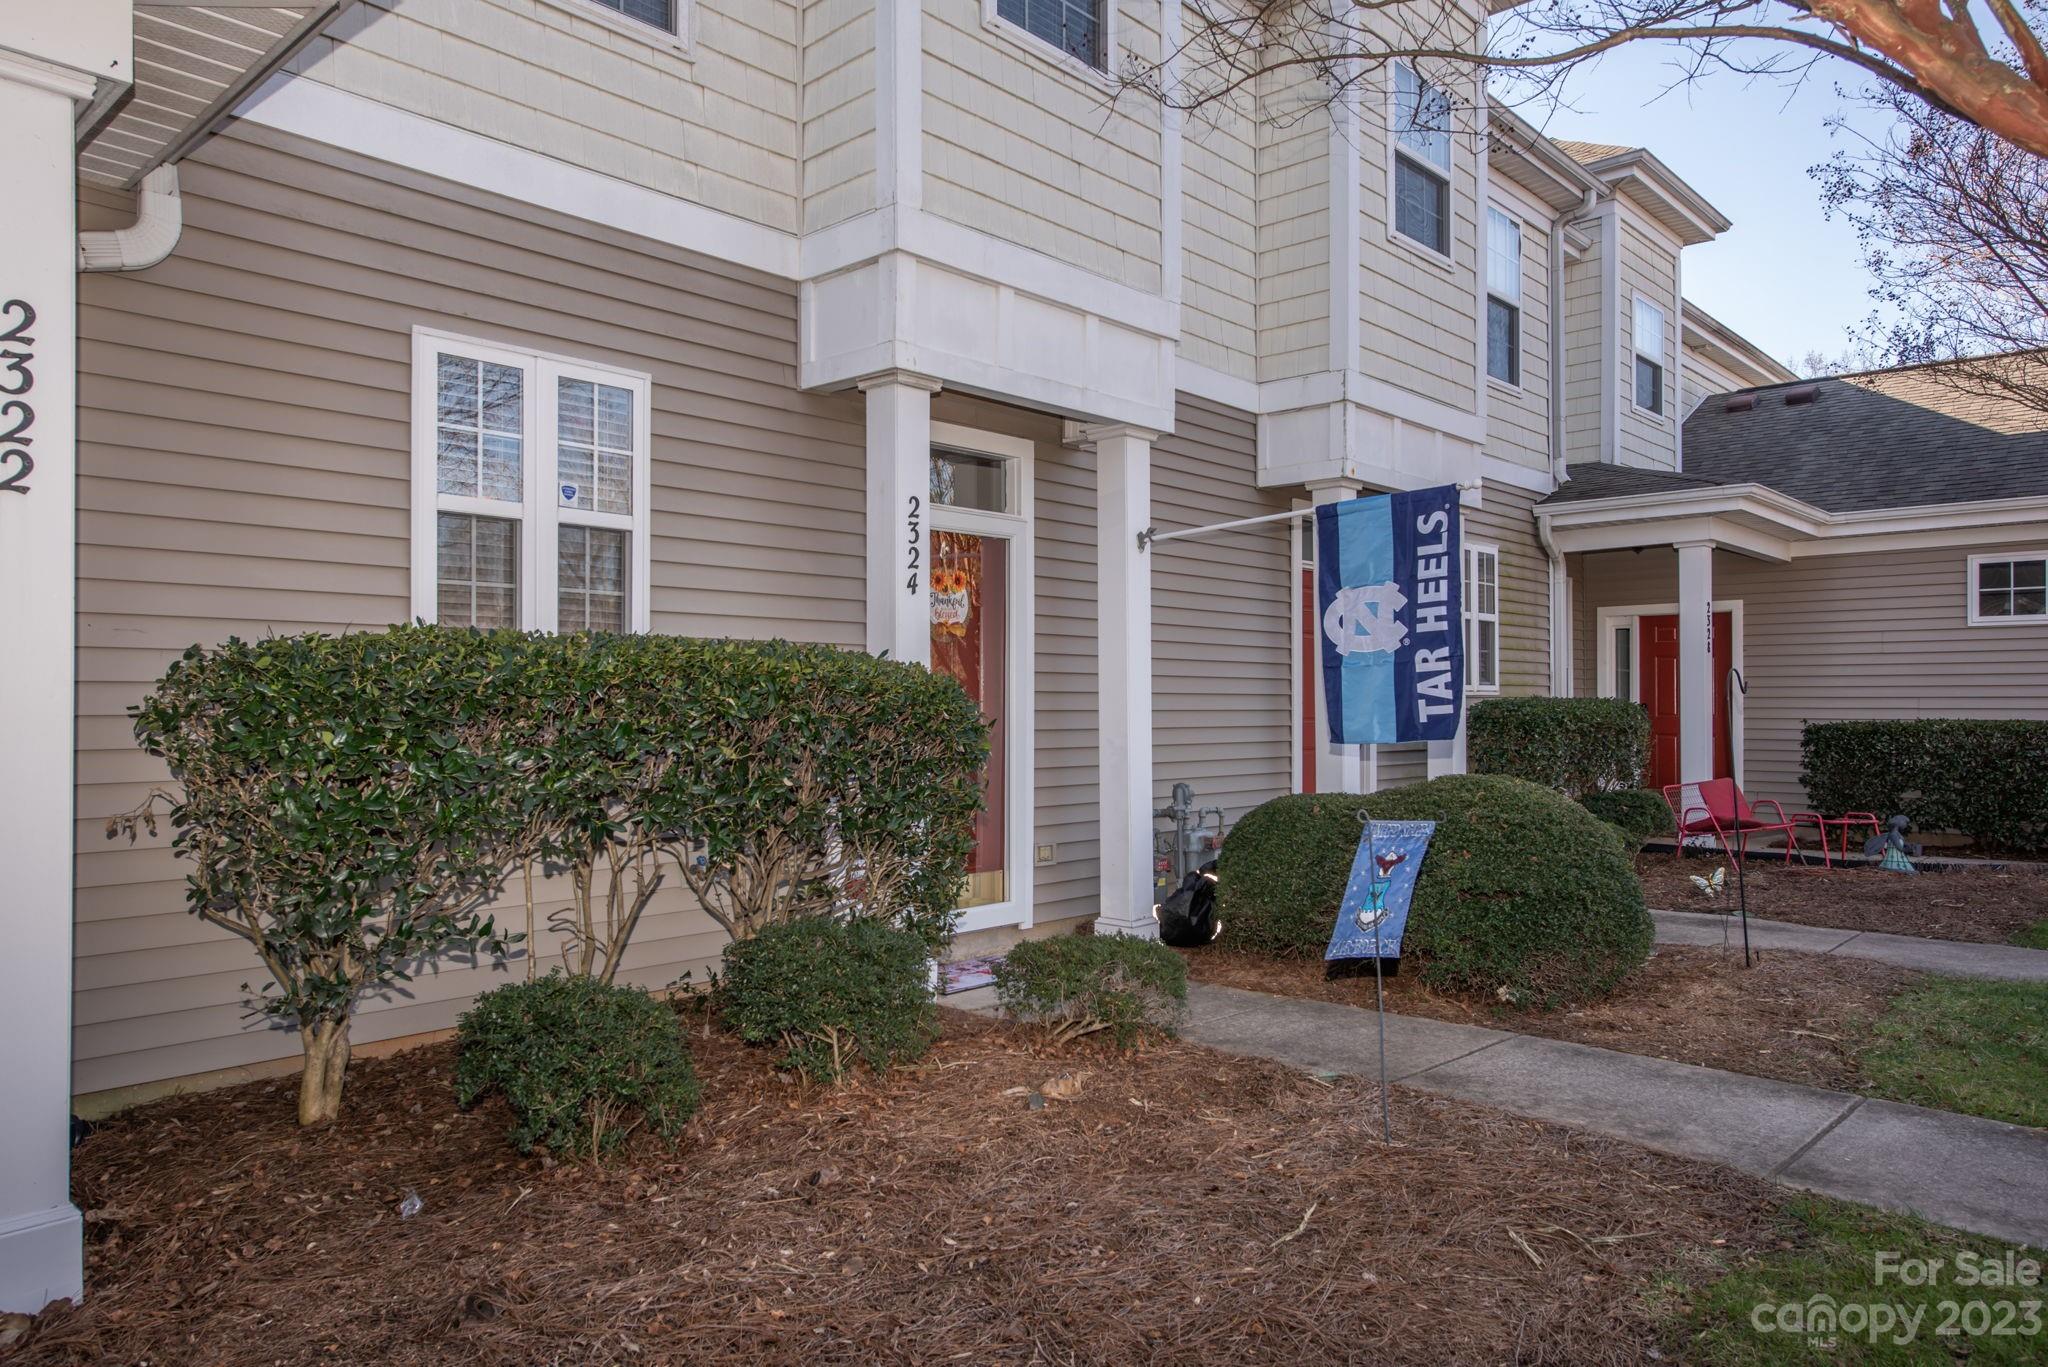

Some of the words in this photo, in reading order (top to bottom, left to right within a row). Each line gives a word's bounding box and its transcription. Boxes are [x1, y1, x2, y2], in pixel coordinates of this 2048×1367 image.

[0, 299, 36, 494] 2322
[907, 495, 920, 595] 2324
[1415, 646, 1454, 723] TAR
